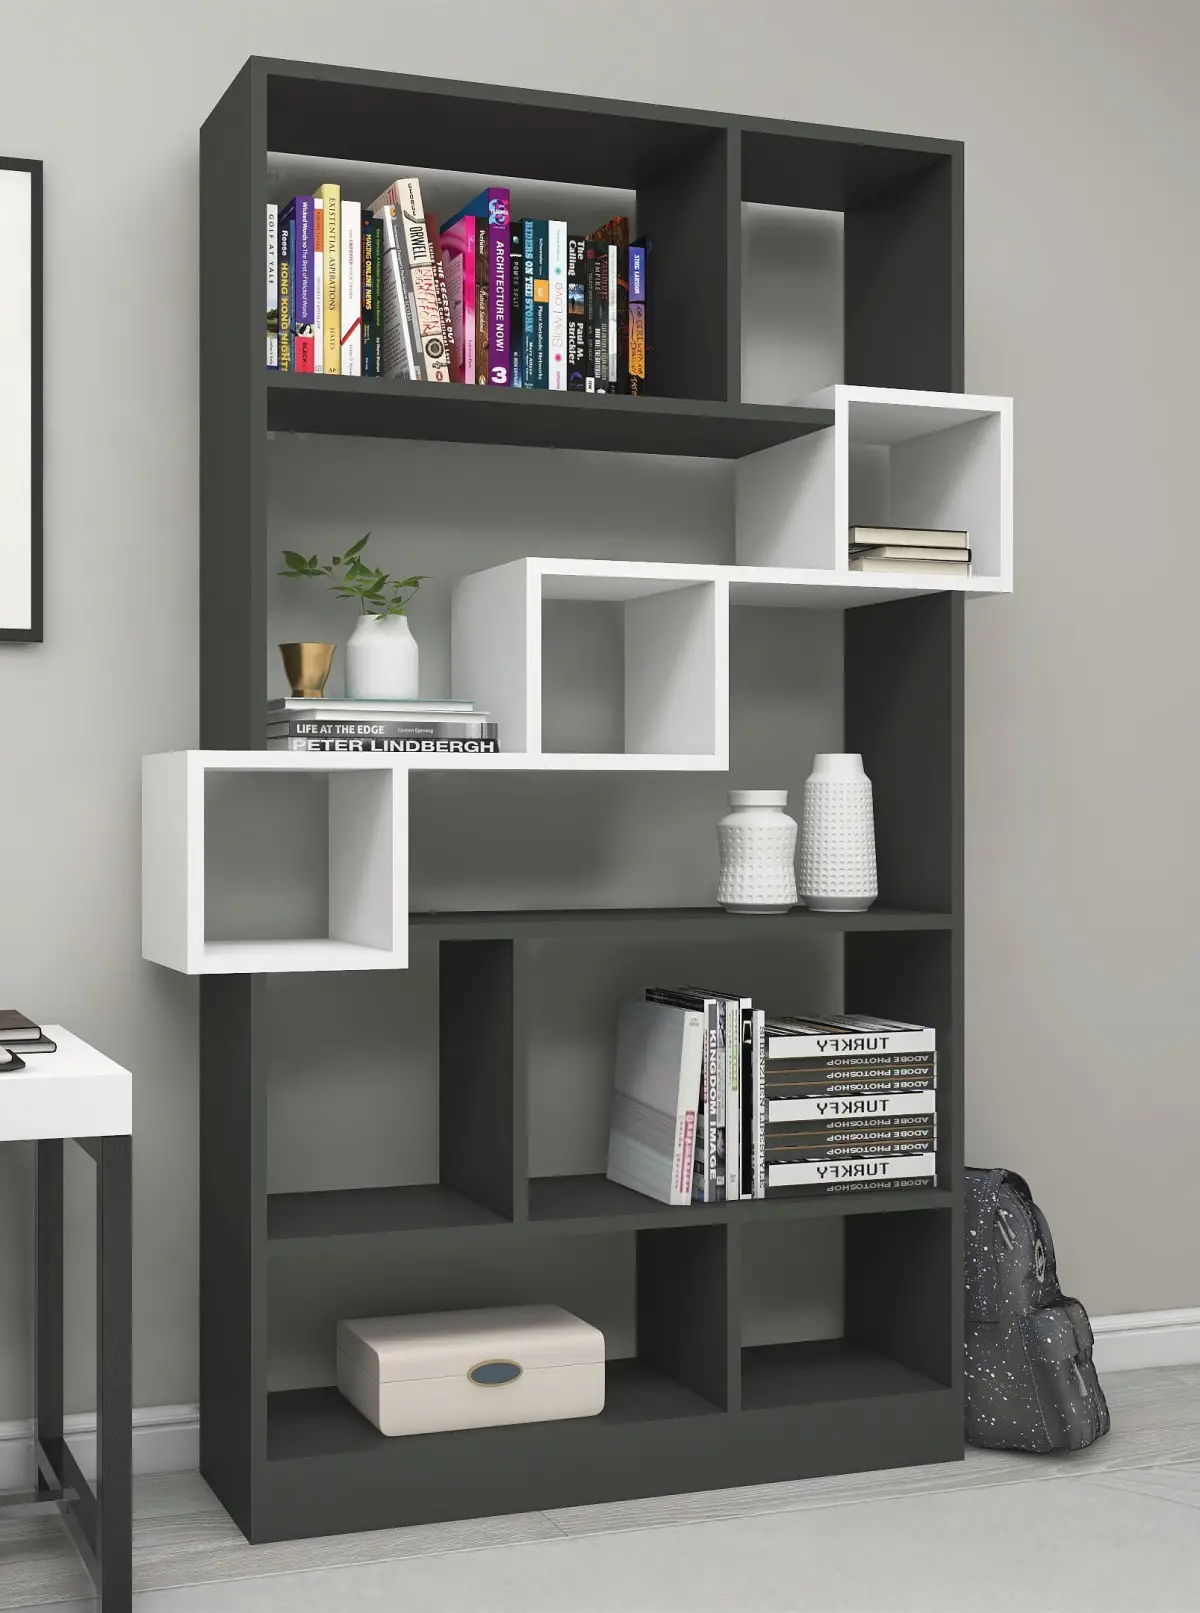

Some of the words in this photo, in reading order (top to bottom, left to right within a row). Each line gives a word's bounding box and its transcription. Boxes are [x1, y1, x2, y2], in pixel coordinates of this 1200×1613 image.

[410, 226, 427, 260] ORWELL
[525, 221, 533, 258] RIDERS
[268, 244, 274, 256] AT
[577, 241, 585, 260] The
[568, 240, 576, 276] Calling
[436, 261, 444, 278] THE
[525, 261, 533, 274] ON
[496, 241, 504, 320] ARCHITECTURE
[525, 276, 533, 297] THE
[525, 299, 533, 333] STORM
[496, 324, 504, 352] NOW!
[568, 322, 576, 364] Strickler
[577, 347, 584, 360] M.
[491, 366, 507, 384] 3
[296, 724, 317, 734] LIFE
[320, 724, 333, 734] AT
[335, 725, 354, 734] THE
[358, 725, 384, 734] EDGE
[292, 739, 363, 751] PETER
[371, 740, 494, 753] LINDBERGH
[827, 1057, 890, 1066] PHOTOSHOP
[709, 1030, 717, 1116] KINGDOM
[827, 1070, 890, 1078] PHOTOSHOP
[827, 1082, 890, 1091] PHOTOSHOP
[827, 1119, 890, 1128] PHOTOSHOP
[827, 1132, 890, 1141] PHOTOSHOP
[709, 1121, 717, 1180] IMAGE
[827, 1145, 890, 1154] PHOTOSHOP
[827, 1182, 890, 1192] PHOTOSHOP
[894, 1179, 929, 1187] ADOBE
